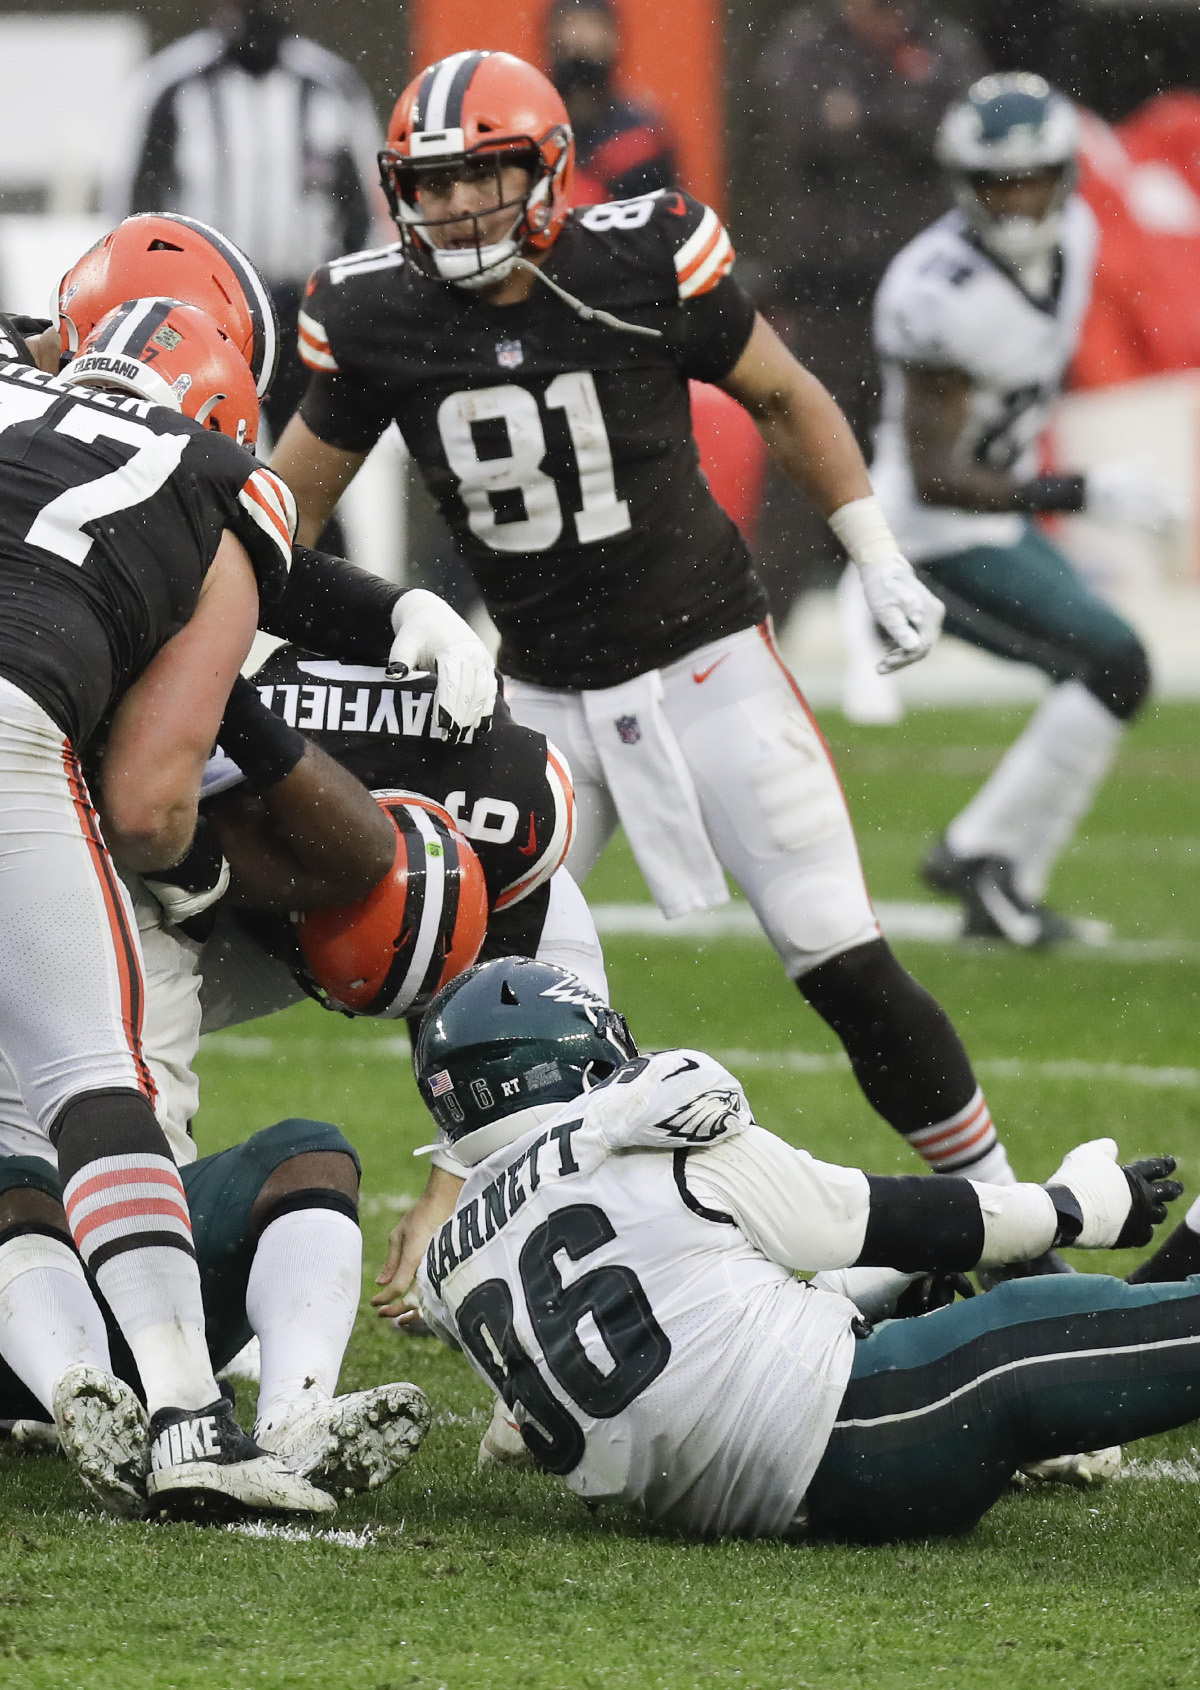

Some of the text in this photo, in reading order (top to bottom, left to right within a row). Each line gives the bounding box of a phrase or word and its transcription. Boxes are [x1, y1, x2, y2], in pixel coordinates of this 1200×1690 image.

[73, 356, 140, 380] CLEVELAND
[437, 371, 632, 552] 81
[501, 1077, 521, 1097] RT
[426, 1117, 585, 1300] BARNETT
[455, 1203, 672, 1475] 96
[151, 1416, 221, 1472] NIKE
